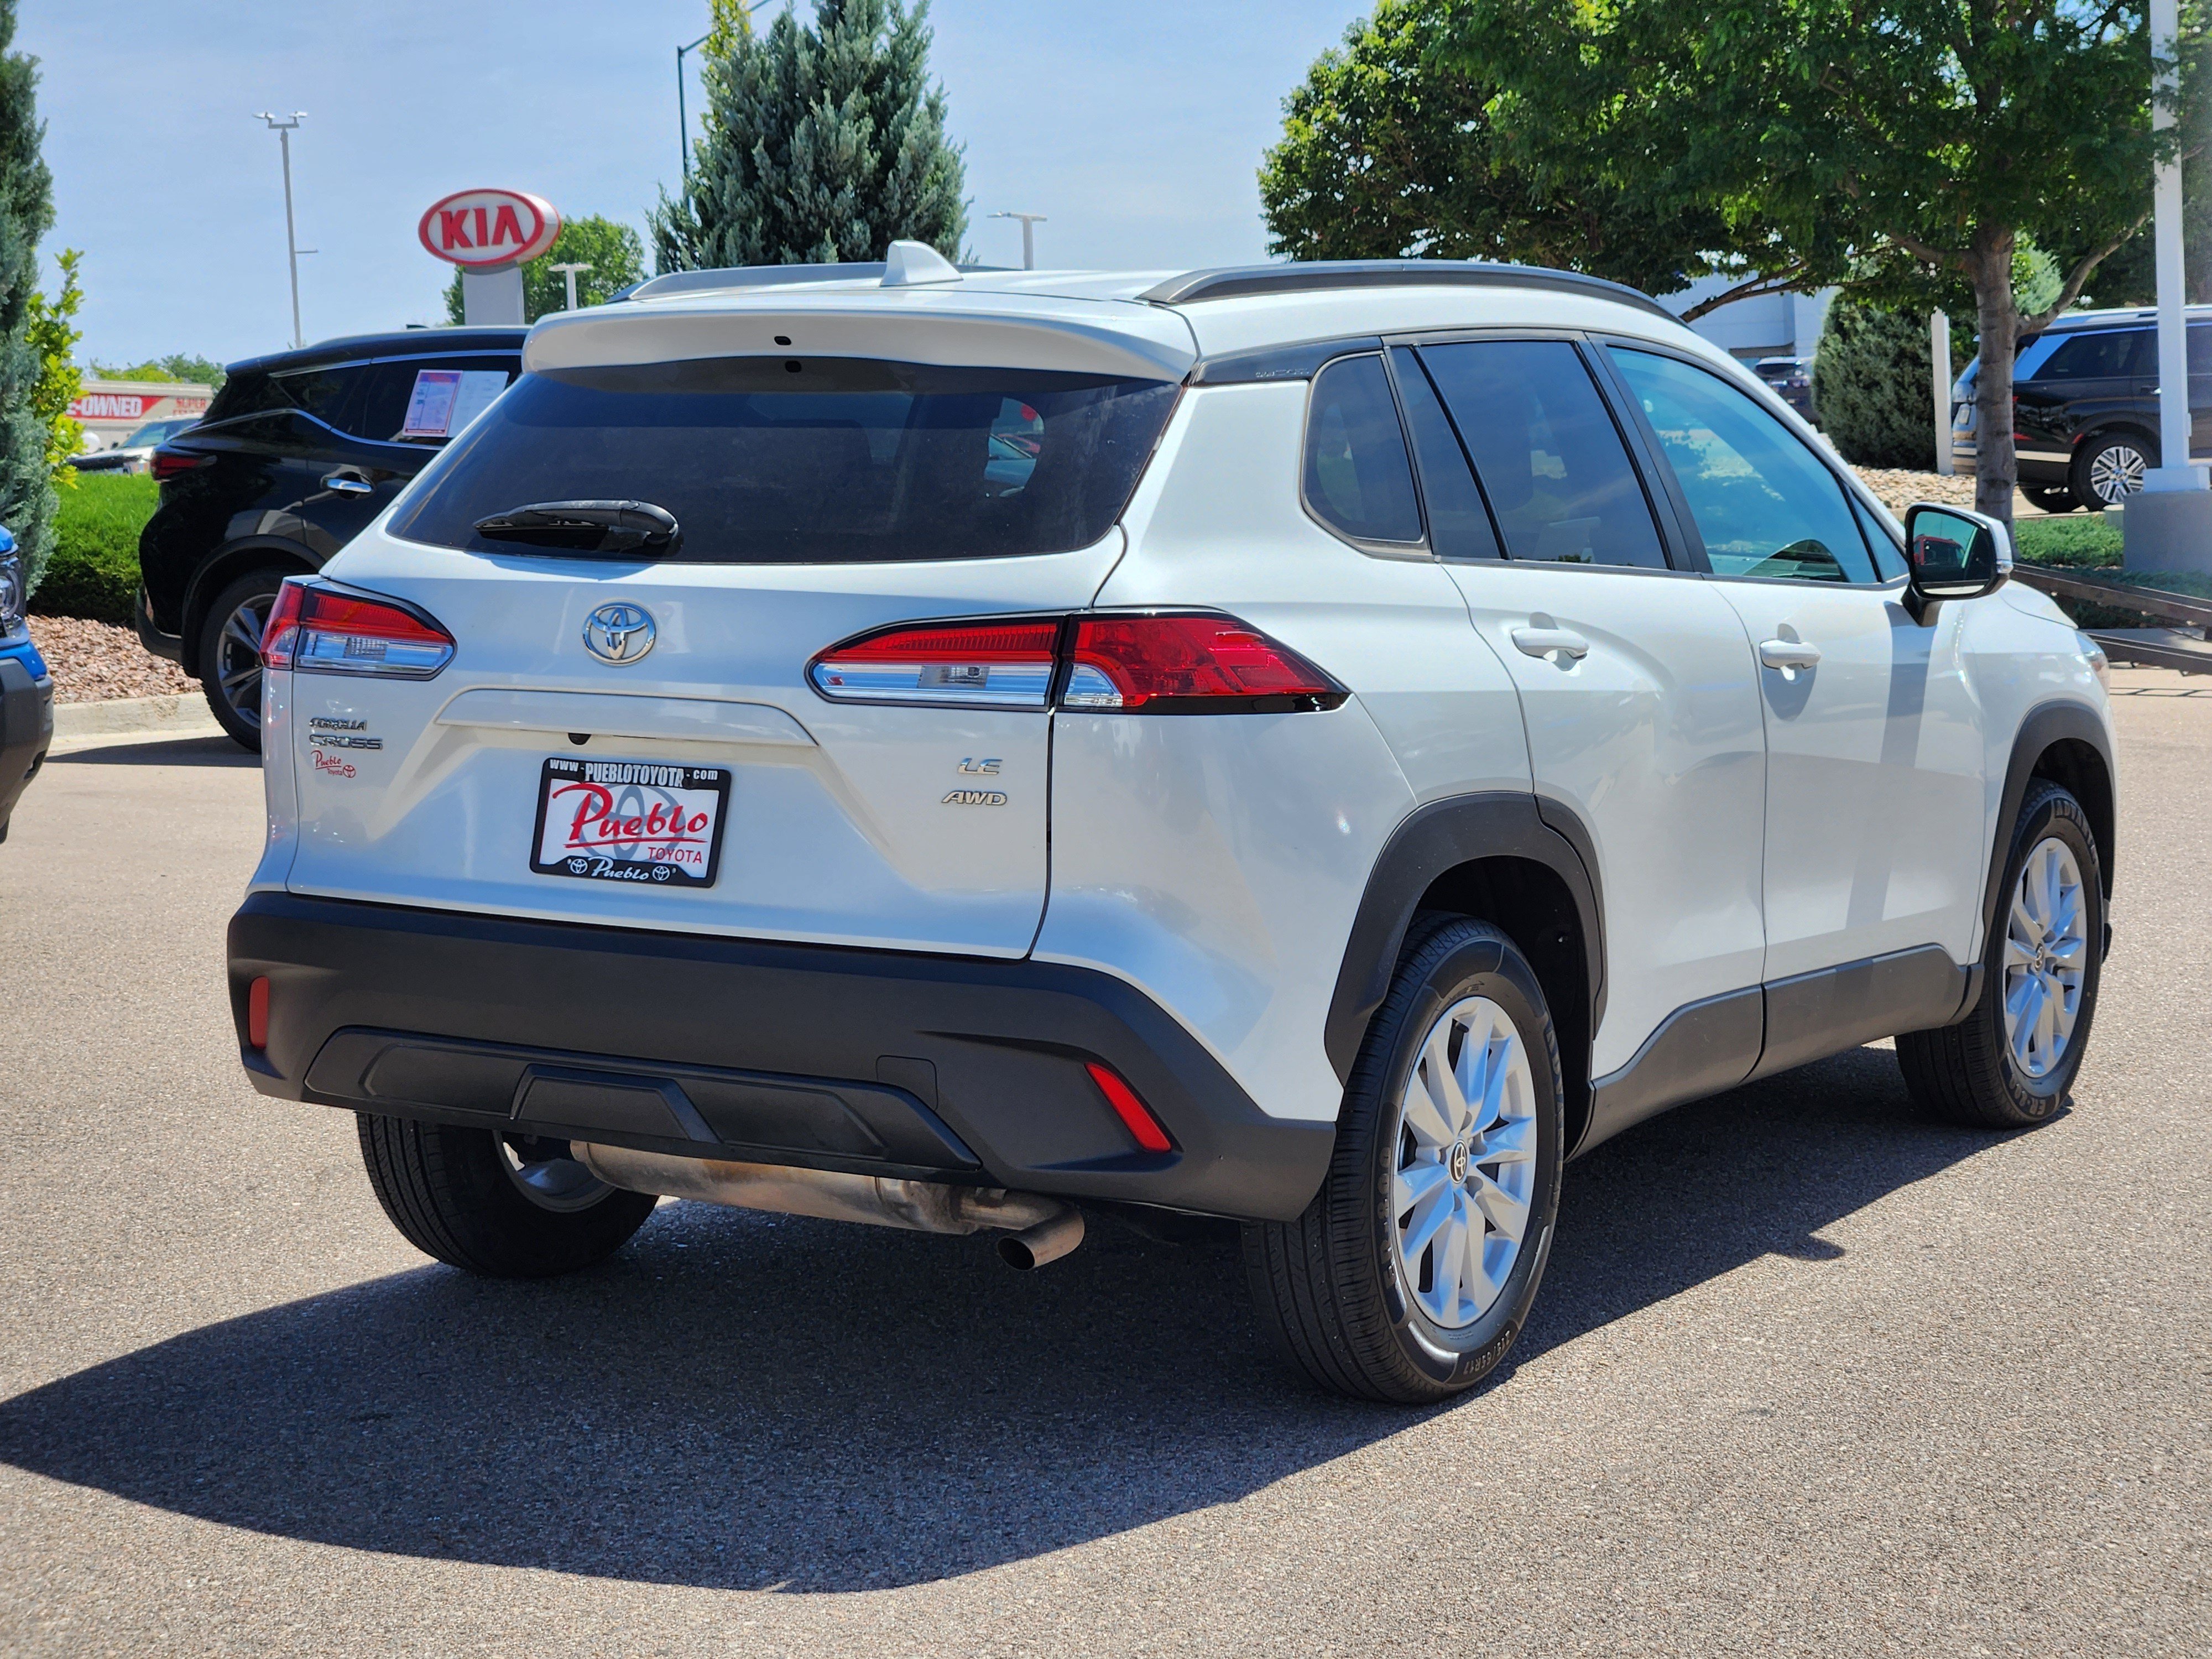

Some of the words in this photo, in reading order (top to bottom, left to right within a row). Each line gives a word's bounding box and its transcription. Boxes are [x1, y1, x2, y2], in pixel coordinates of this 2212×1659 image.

[439, 205, 526, 250] KIA
[309, 734, 383, 750] CROSS
[310, 750, 342, 767] Pueblo
[957, 758, 1003, 775] LE
[941, 790, 1008, 806] AWD
[552, 783, 708, 841] Pueblo
[648, 847, 702, 864] TOYOTA
[588, 857, 649, 880] Pueblo
